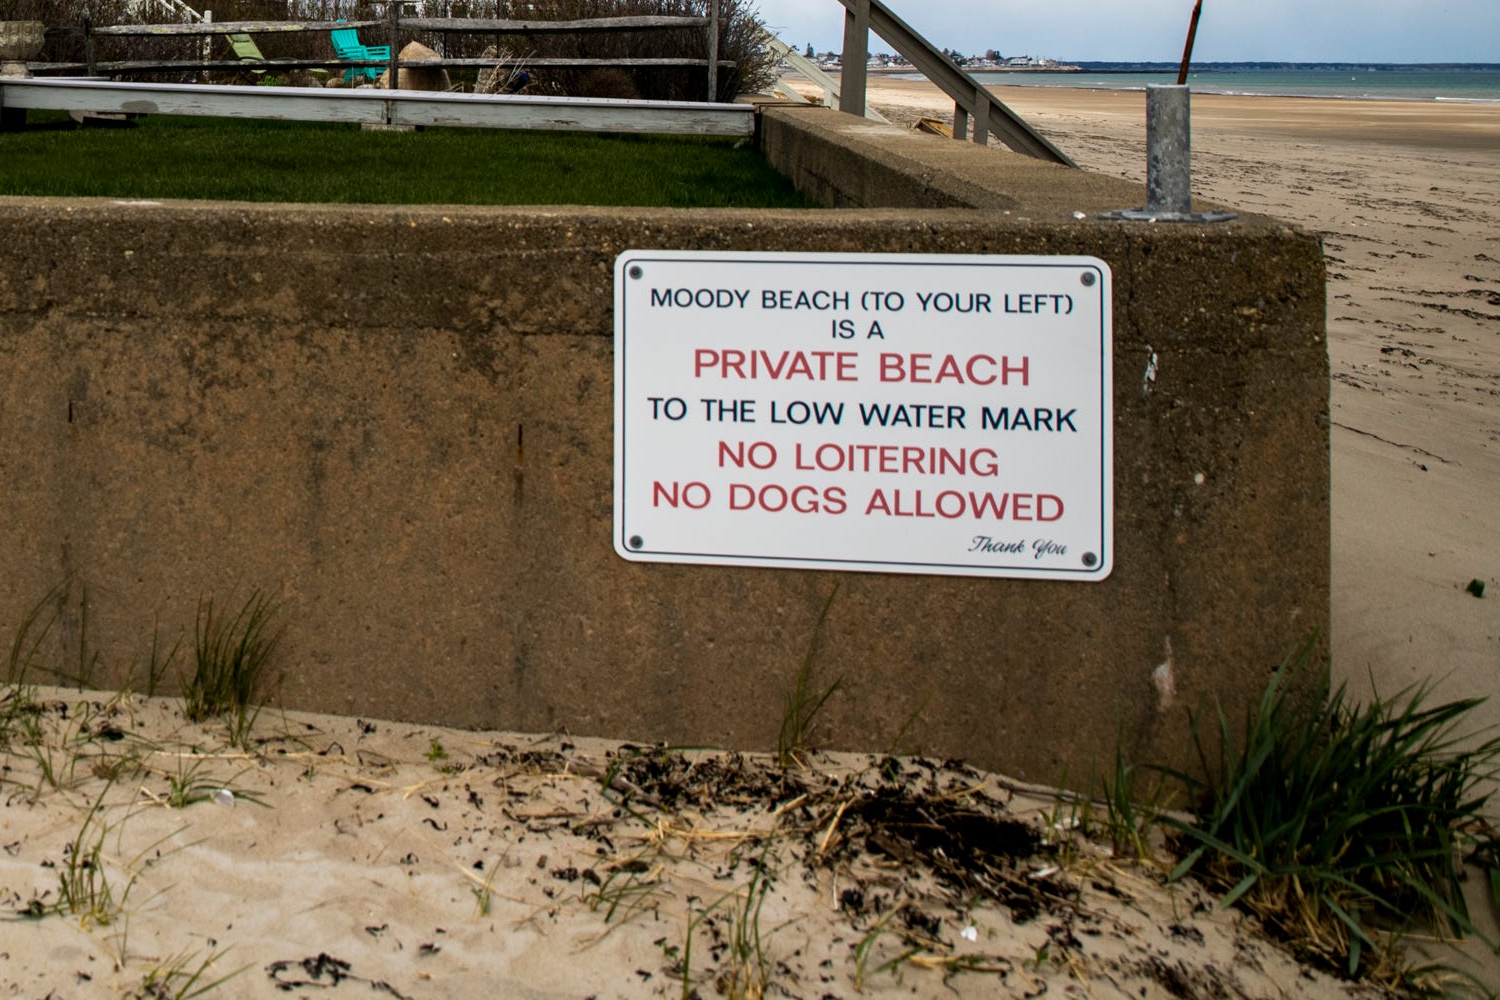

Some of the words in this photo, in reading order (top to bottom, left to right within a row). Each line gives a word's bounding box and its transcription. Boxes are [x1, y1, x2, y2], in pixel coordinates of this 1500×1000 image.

[651, 288, 750, 308] MOODY
[762, 290, 849, 311] BEACH
[861, 291, 905, 312] (TO
[916, 292, 992, 313] YOUR
[1004, 294, 1074, 315] LEFT)
[832, 319, 855, 339] IS
[867, 320, 884, 339] A
[695, 349, 858, 381] PRIVATE
[880, 353, 1029, 386] BEACH
[647, 397, 687, 421] TO
[700, 399, 756, 423] THE
[771, 401, 844, 425] LOW
[859, 403, 966, 429] WATER
[982, 406, 1077, 433] MARK
[719, 441, 777, 469] NO
[796, 443, 998, 477] LOITERING
[653, 481, 711, 509] NO
[729, 484, 847, 514] DOGS
[865, 489, 1064, 522] ALLOWED
[968, 535, 1026, 555] Thank
[1032, 538, 1068, 560] You
